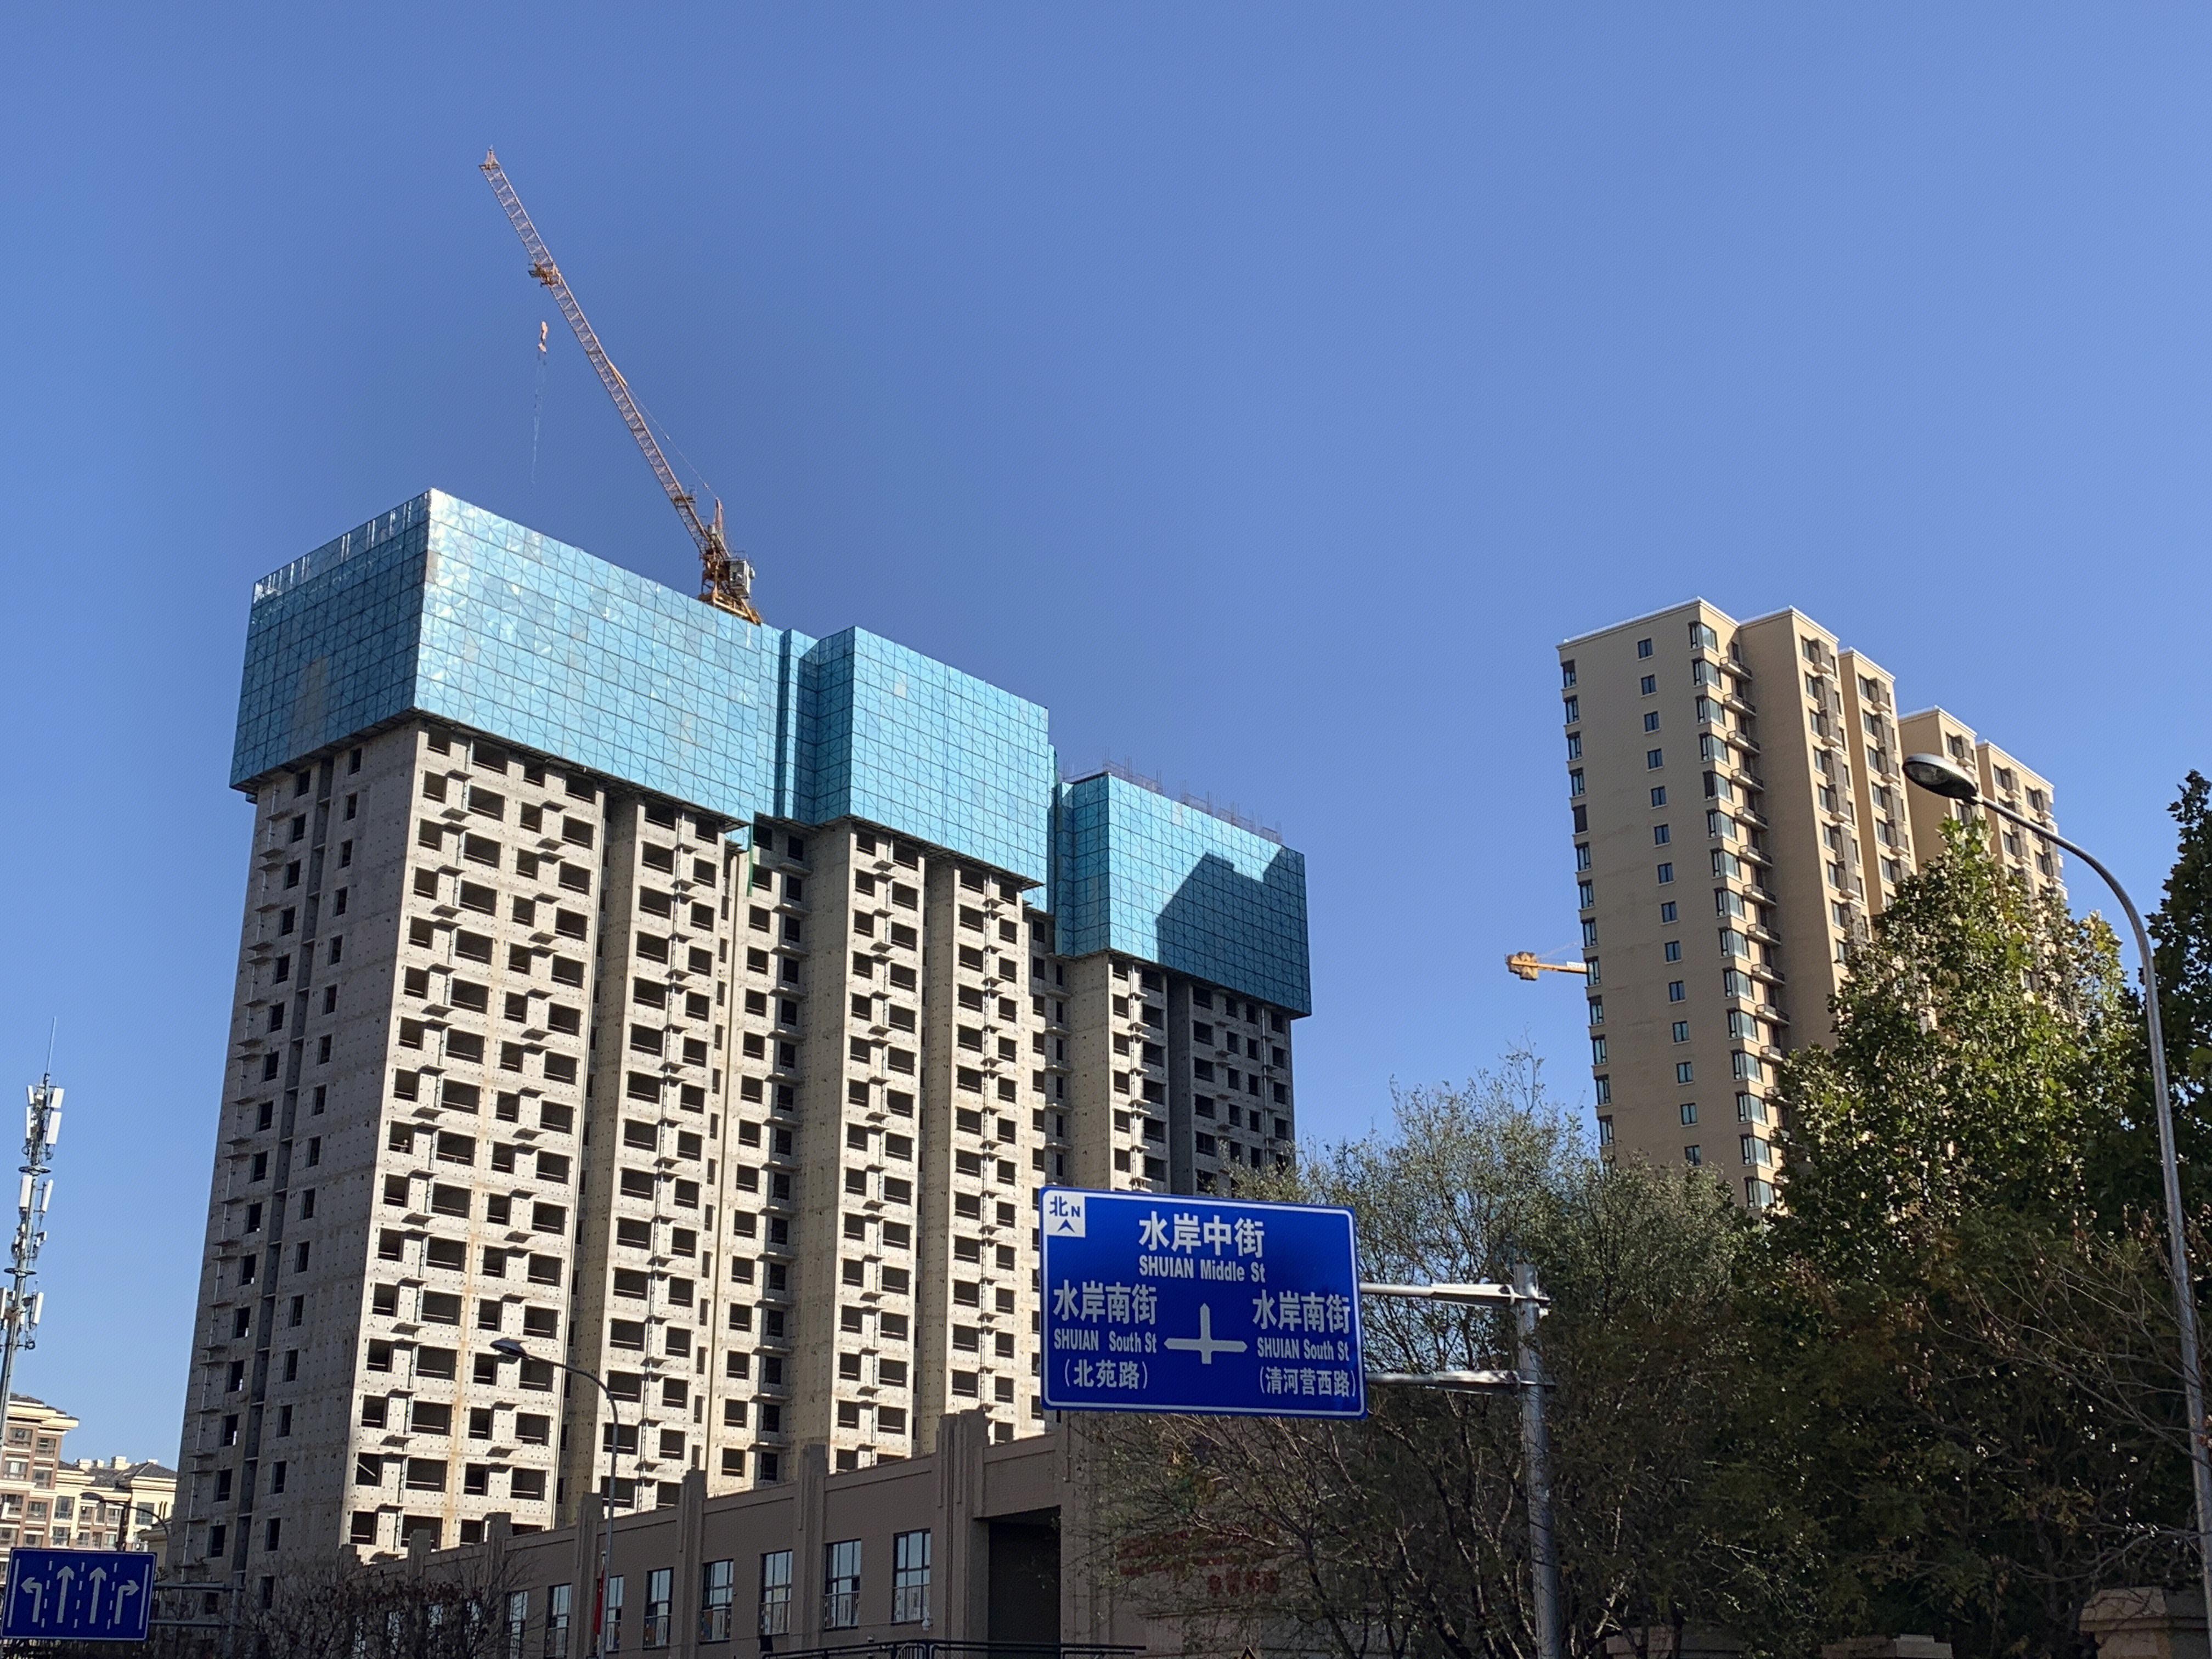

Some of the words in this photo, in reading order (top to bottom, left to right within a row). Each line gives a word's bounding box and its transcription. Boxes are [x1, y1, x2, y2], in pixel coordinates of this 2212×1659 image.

[1049, 1195, 1069, 1217] 北
[1071, 1205, 1081, 1217] N
[1138, 1210, 1265, 1258] 水岸中街
[1139, 1255, 1194, 1279] SHUIAN
[1200, 1259, 1245, 1282] Middle
[1250, 1261, 1266, 1283] St
[1053, 1279, 1158, 1325] 水岸南街
[1252, 1289, 1351, 1334] 水岸南街
[1054, 1328, 1099, 1351] SHUIAN
[1109, 1330, 1142, 1353] South
[1144, 1331, 1157, 1353] St
[1257, 1336, 1300, 1359] SHUIAN
[1303, 1338, 1335, 1361] South
[1337, 1340, 1350, 1361] St
[1065, 1358, 1148, 1390] (北苑路)
